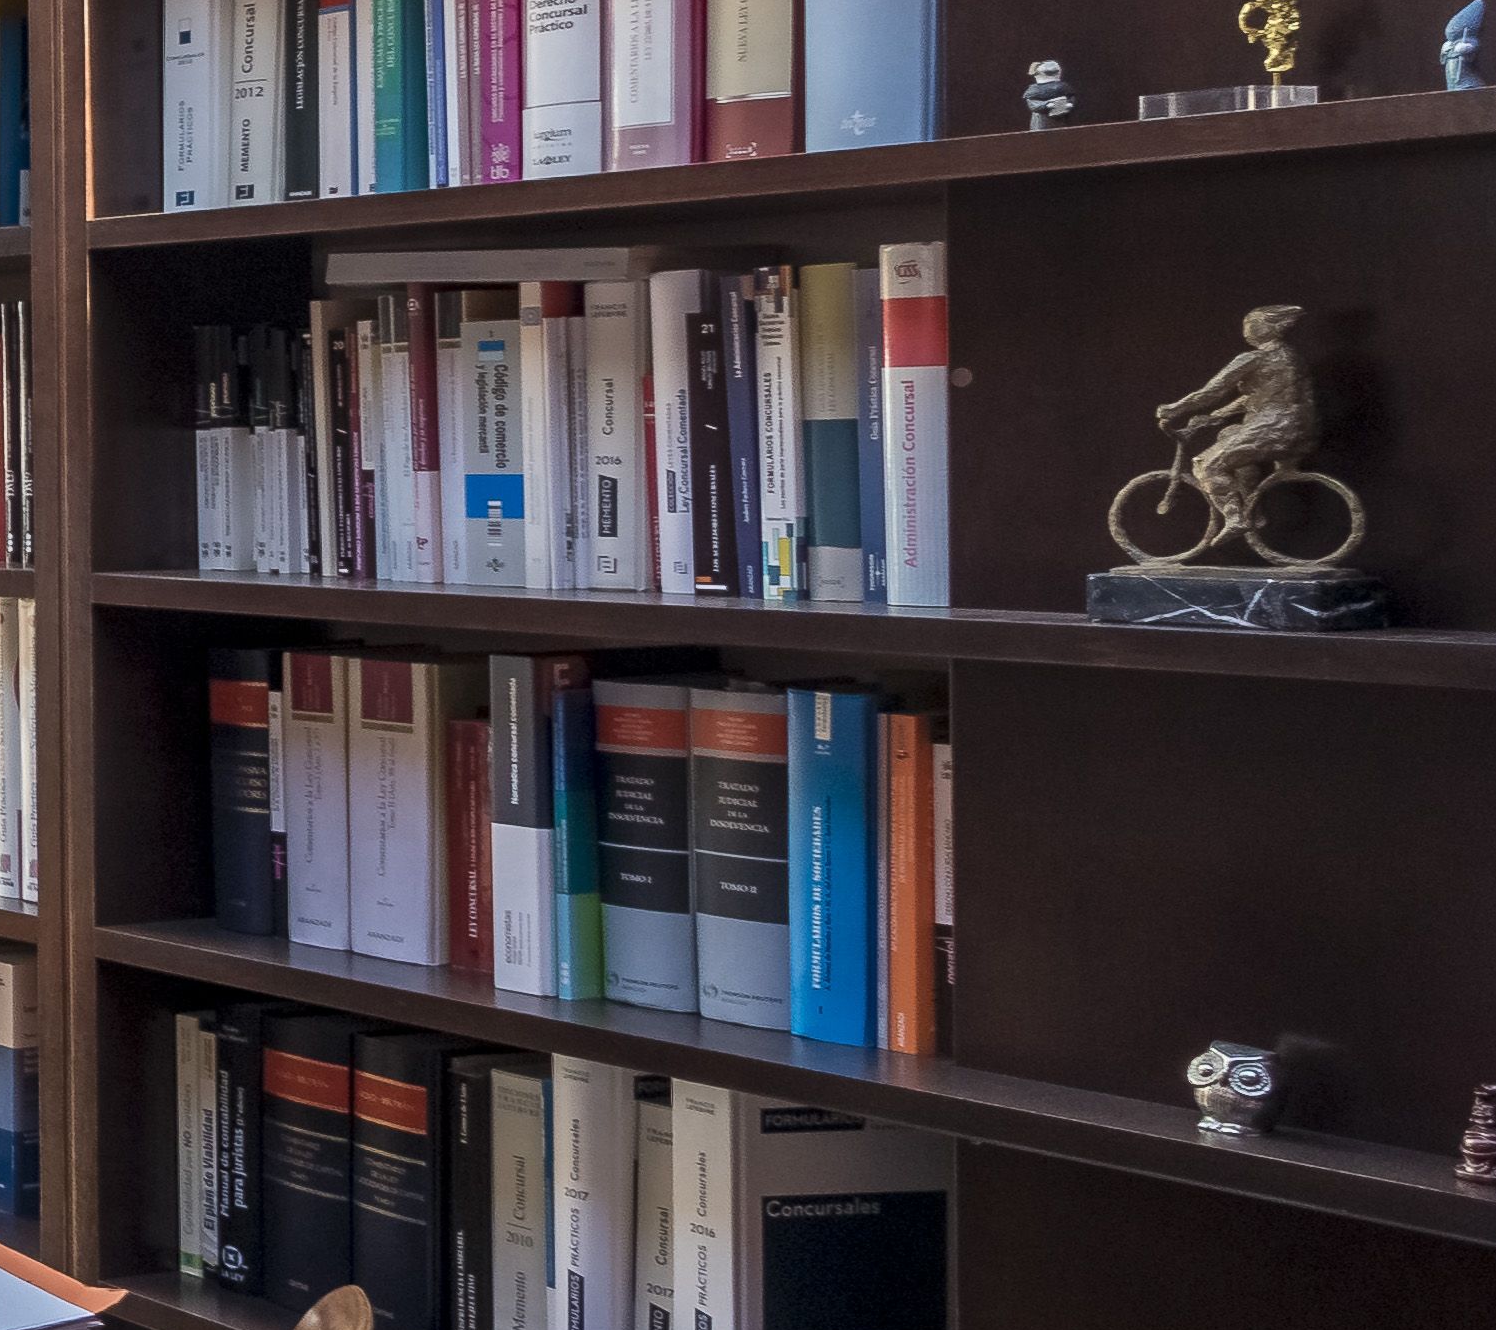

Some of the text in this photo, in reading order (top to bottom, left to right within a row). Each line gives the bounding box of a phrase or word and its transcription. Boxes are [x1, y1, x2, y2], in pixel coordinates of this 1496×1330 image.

[529, 4, 588, 22] Concursal
[234, 3, 264, 173] MEMENTO 2012 Concursal
[492, 364, 510, 469] Código de comercio
[763, 372, 775, 494] FORMULARIOS CONCURSALES
[595, 378, 623, 535] MEMENTO 2016 Concursal
[675, 389, 693, 513] Ley Concursal Comentada
[900, 379, 918, 569] Administración Concursal
[718, 781, 759, 793] TRATADO
[718, 796, 759, 808] JUDICIAL
[710, 818, 769, 834] INSOLVENCIA
[620, 872, 646, 883] TOMO
[720, 881, 747, 893] TOMO
[201, 1108, 214, 1170] Viabilidad
[218, 1069, 230, 1218] Manual de contabilidad
[231, 1128, 248, 1209] para juristas
[569, 1117, 580, 1182] Concursales
[202, 1172, 214, 1188] de
[511, 1154, 527, 1222] Concursal
[696, 1150, 707, 1218] Concursales
[766, 1198, 882, 1219] Concursales
[568, 1207, 580, 1268] PRÁCTICOS
[654, 1206, 670, 1267] Concursal
[646, 1282, 674, 1298] 2017
[696, 1244, 707, 1307] PRÁCTICOS
